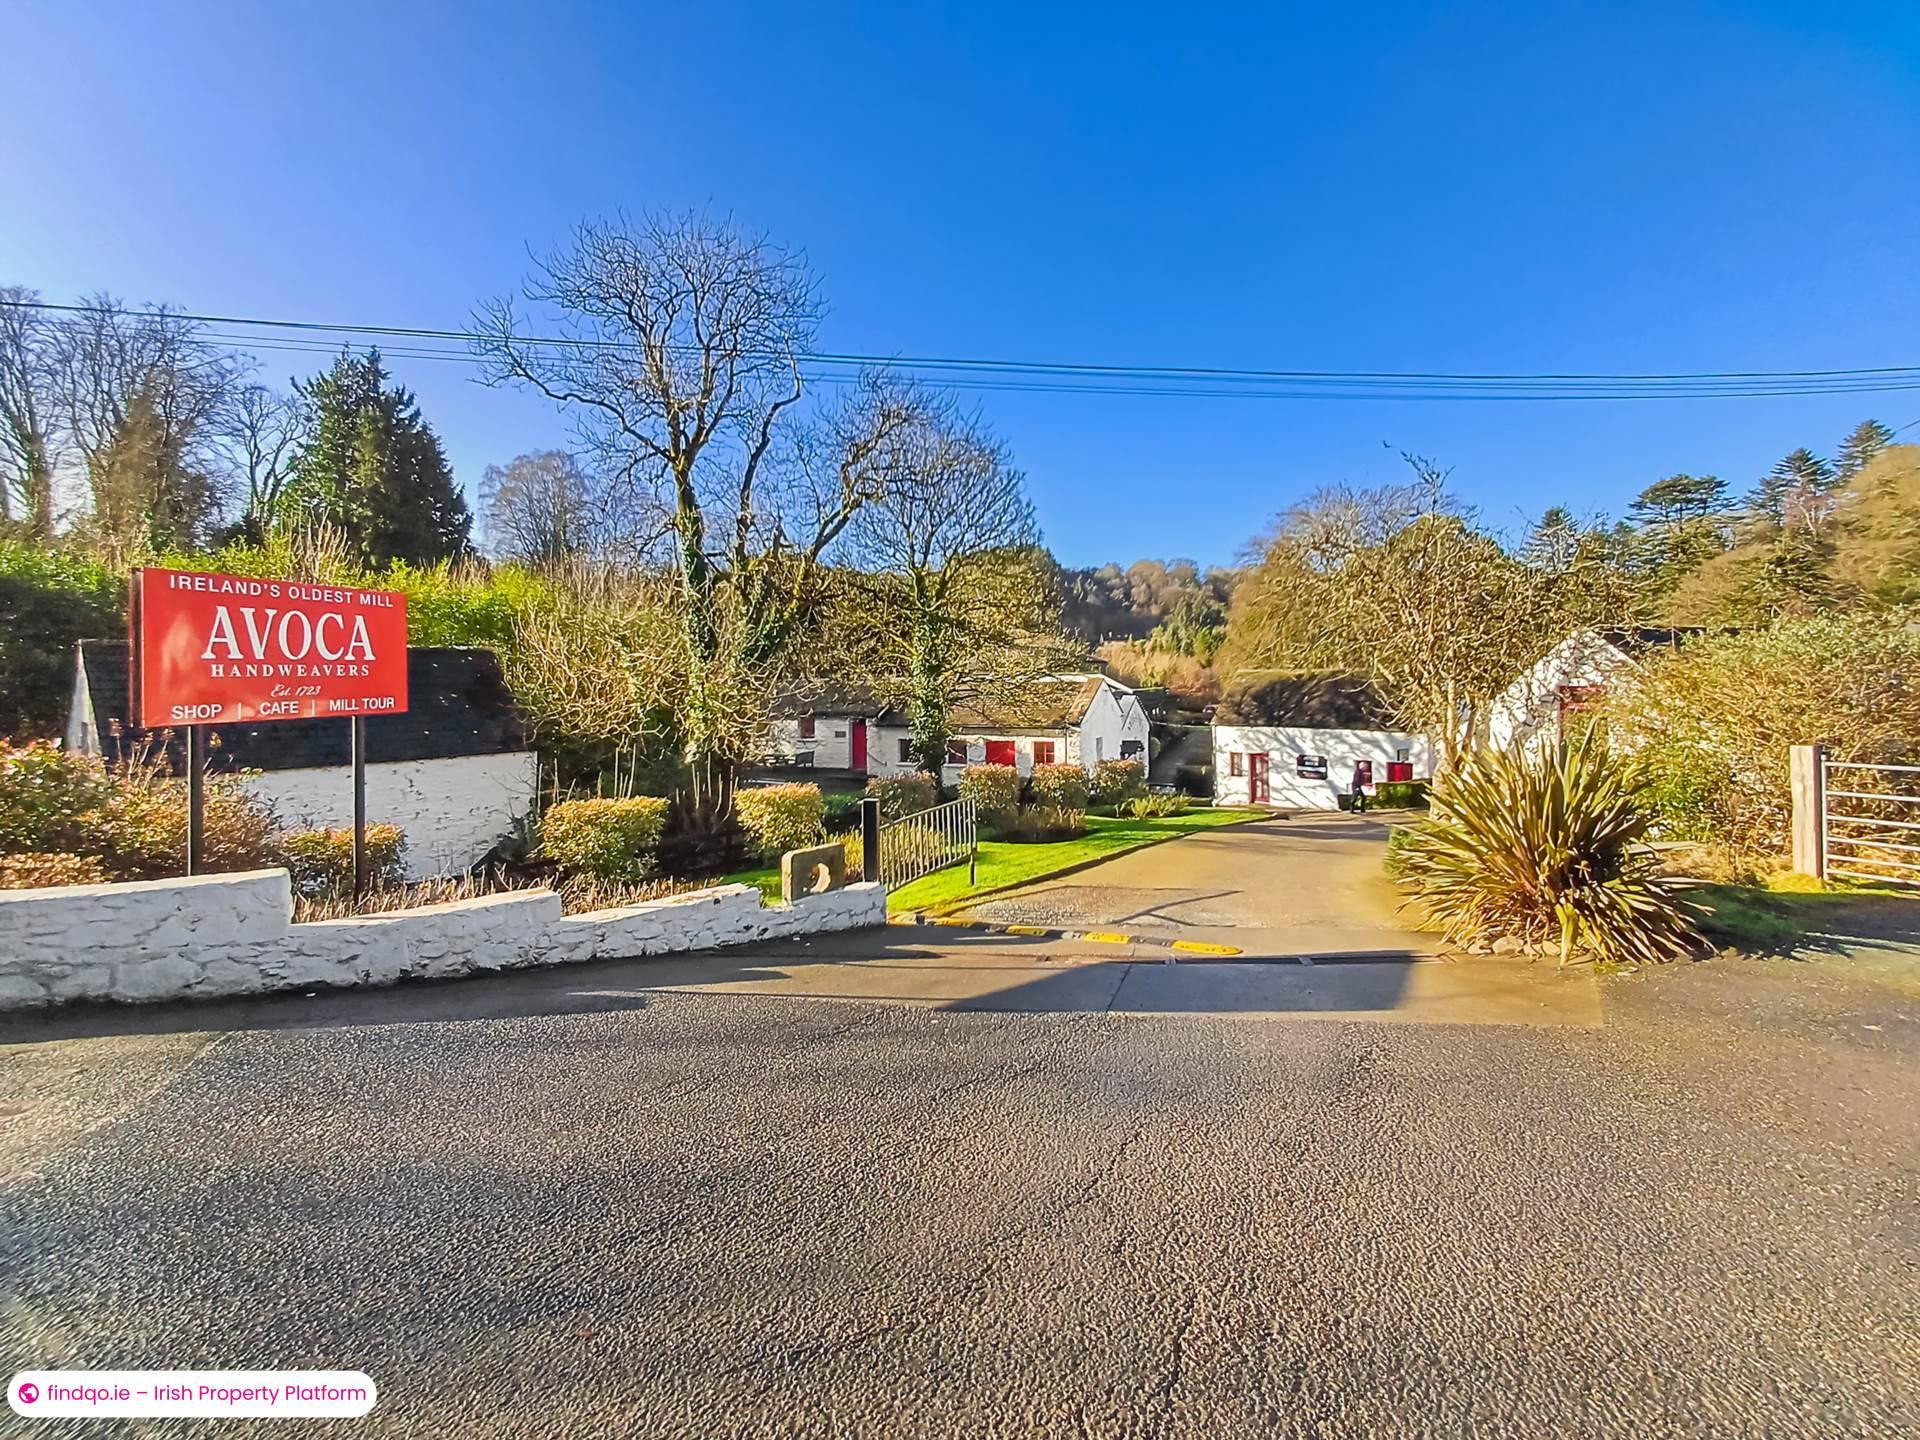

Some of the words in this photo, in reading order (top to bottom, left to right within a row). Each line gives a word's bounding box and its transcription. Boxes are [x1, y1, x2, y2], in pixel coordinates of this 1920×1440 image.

[169, 575, 280, 598] IRELAND'S
[288, 587, 353, 604] OLDEST
[360, 593, 394, 608] MILL
[201, 605, 376, 661] AVOCA
[210, 664, 370, 678] HANDWEAVERS
[271, 684, 291, 698] Est.
[294, 684, 322, 697] 1723
[171, 704, 222, 720] SHOP
[259, 700, 299, 716] CAFE
[329, 699, 359, 712] MILL
[362, 697, 395, 710] TOUR
